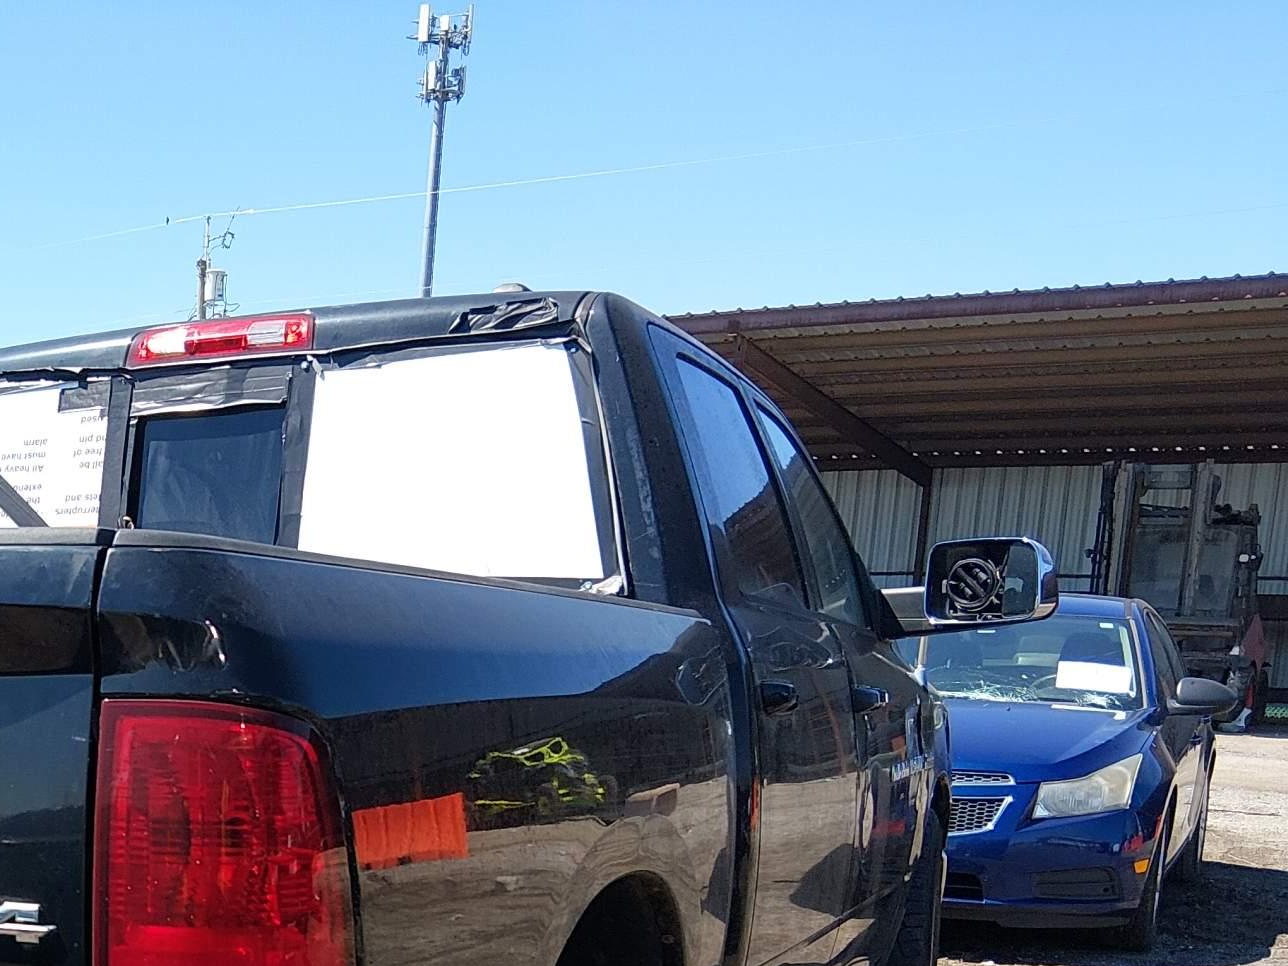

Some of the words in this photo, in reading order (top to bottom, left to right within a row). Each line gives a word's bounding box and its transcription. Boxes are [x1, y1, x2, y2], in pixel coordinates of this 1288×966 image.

[23, 438, 48, 447] alarm
[79, 435, 93, 444] pin
[24, 452, 46, 460] must
[73, 448, 83, 457] of
[85, 448, 103, 456] free
[1, 453, 21, 461] have
[4, 465, 30, 473] heavy
[32, 465, 44, 473] All
[79, 461, 90, 469] be
[26, 496, 40, 505] the
[65, 494, 82, 503] and
